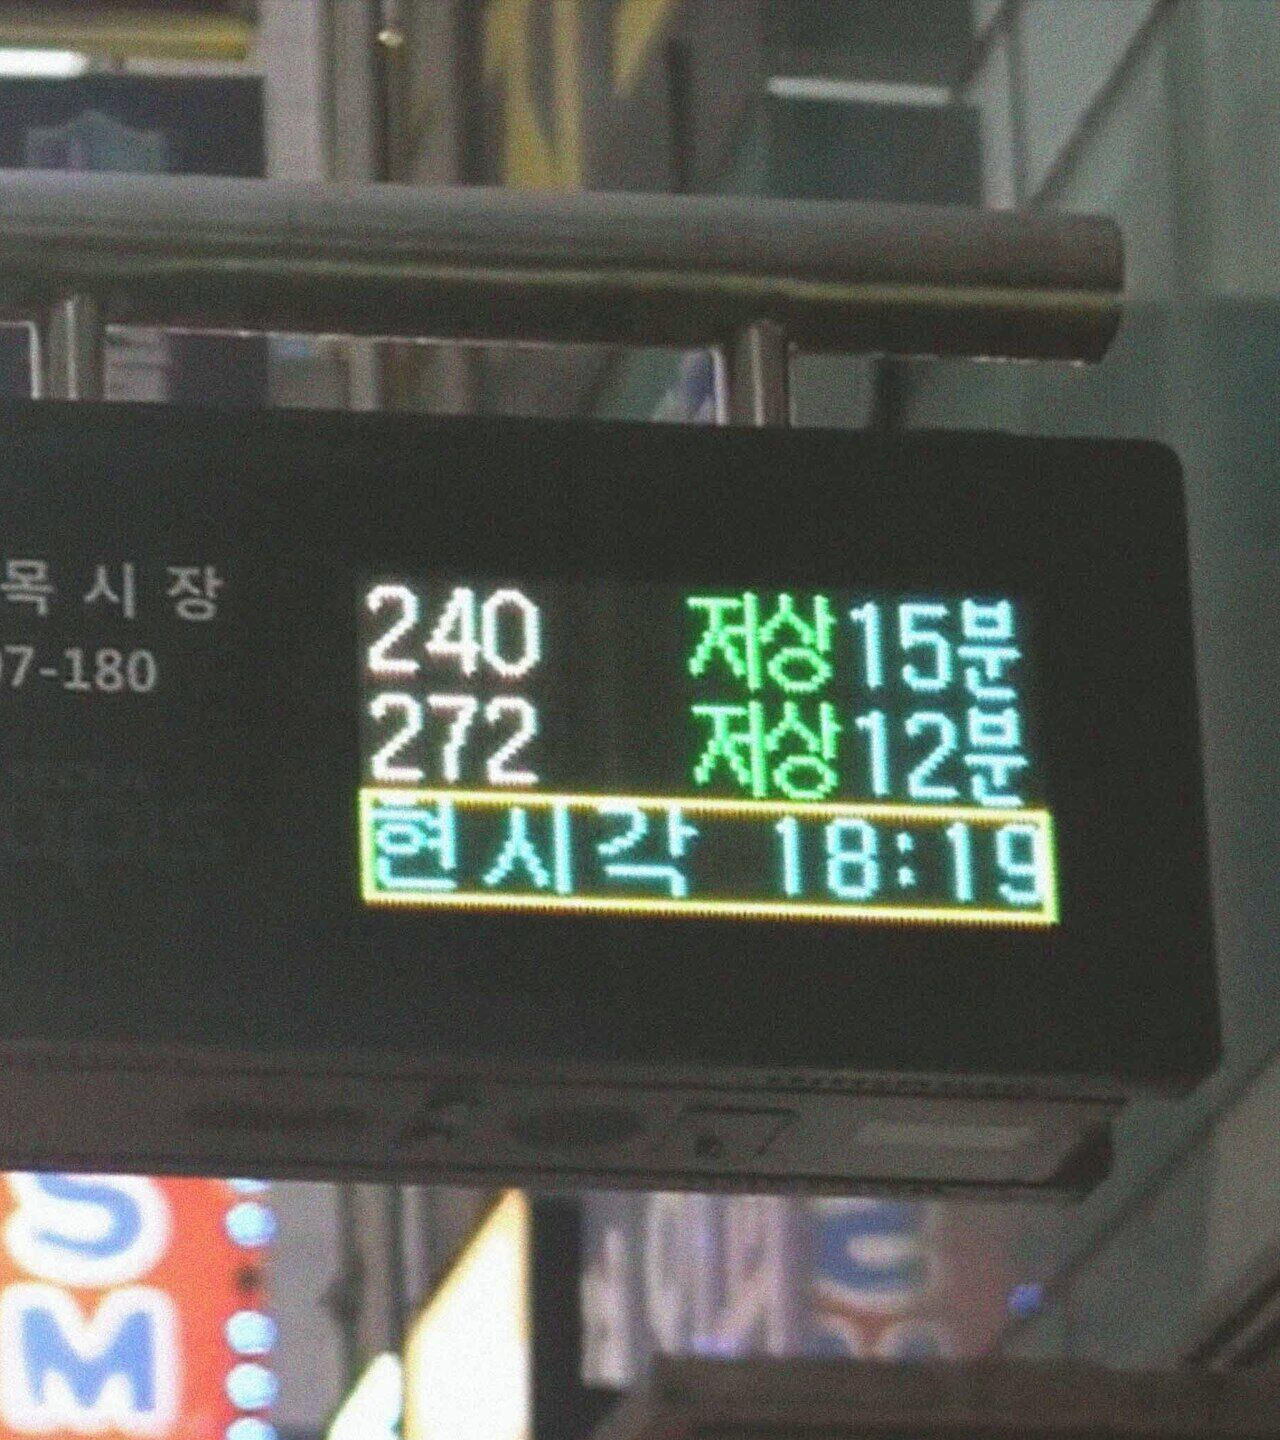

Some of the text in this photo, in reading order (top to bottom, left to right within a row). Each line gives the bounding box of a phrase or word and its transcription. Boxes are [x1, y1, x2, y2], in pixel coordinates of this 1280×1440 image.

[366, 584, 541, 678] 240
[368, 693, 539, 785] 272
[774, 814, 1042, 903] 18:19
